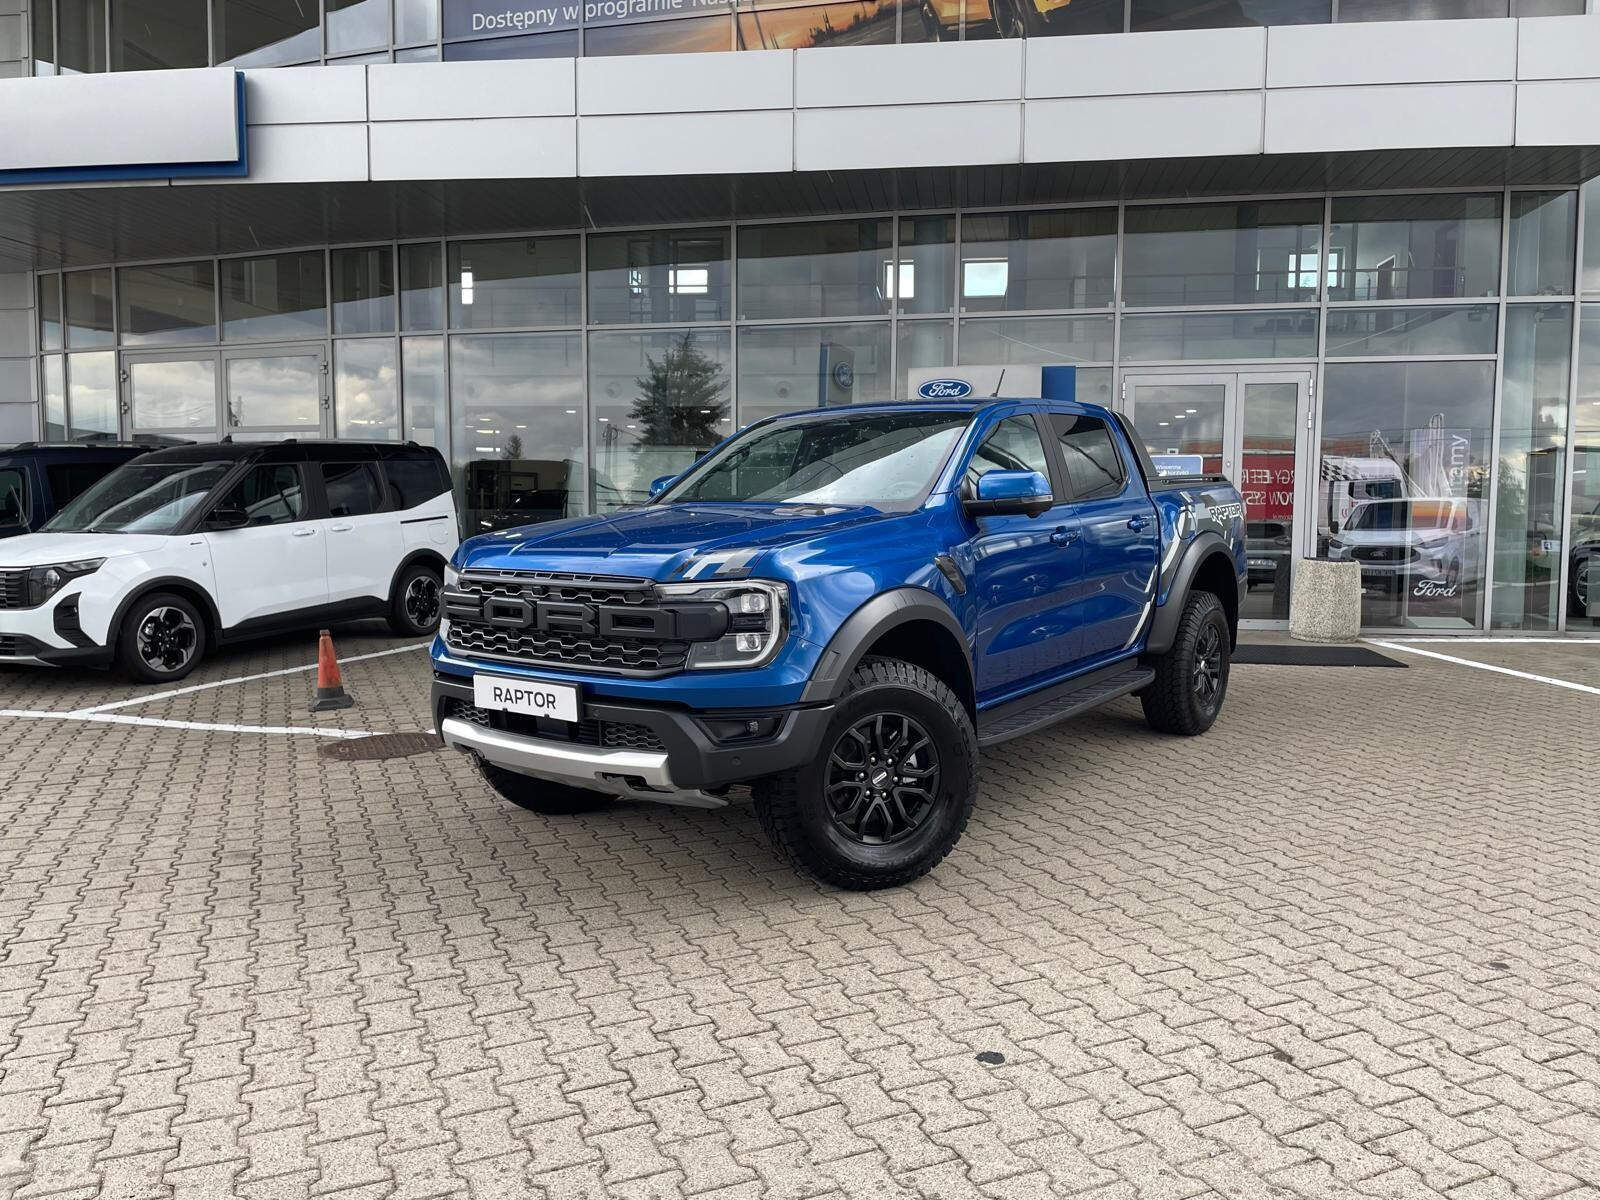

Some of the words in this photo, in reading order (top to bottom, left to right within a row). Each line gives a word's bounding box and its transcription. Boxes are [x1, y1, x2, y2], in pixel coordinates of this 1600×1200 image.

[472, 8, 557, 30] Dostępny
[563, 6, 579, 20] w
[928, 383, 961, 397] Ford
[1208, 503, 1243, 526] RAPTOR
[1413, 580, 1457, 597] Ford
[440, 592, 677, 640] FORD
[493, 686, 556, 709] RAPTOR
